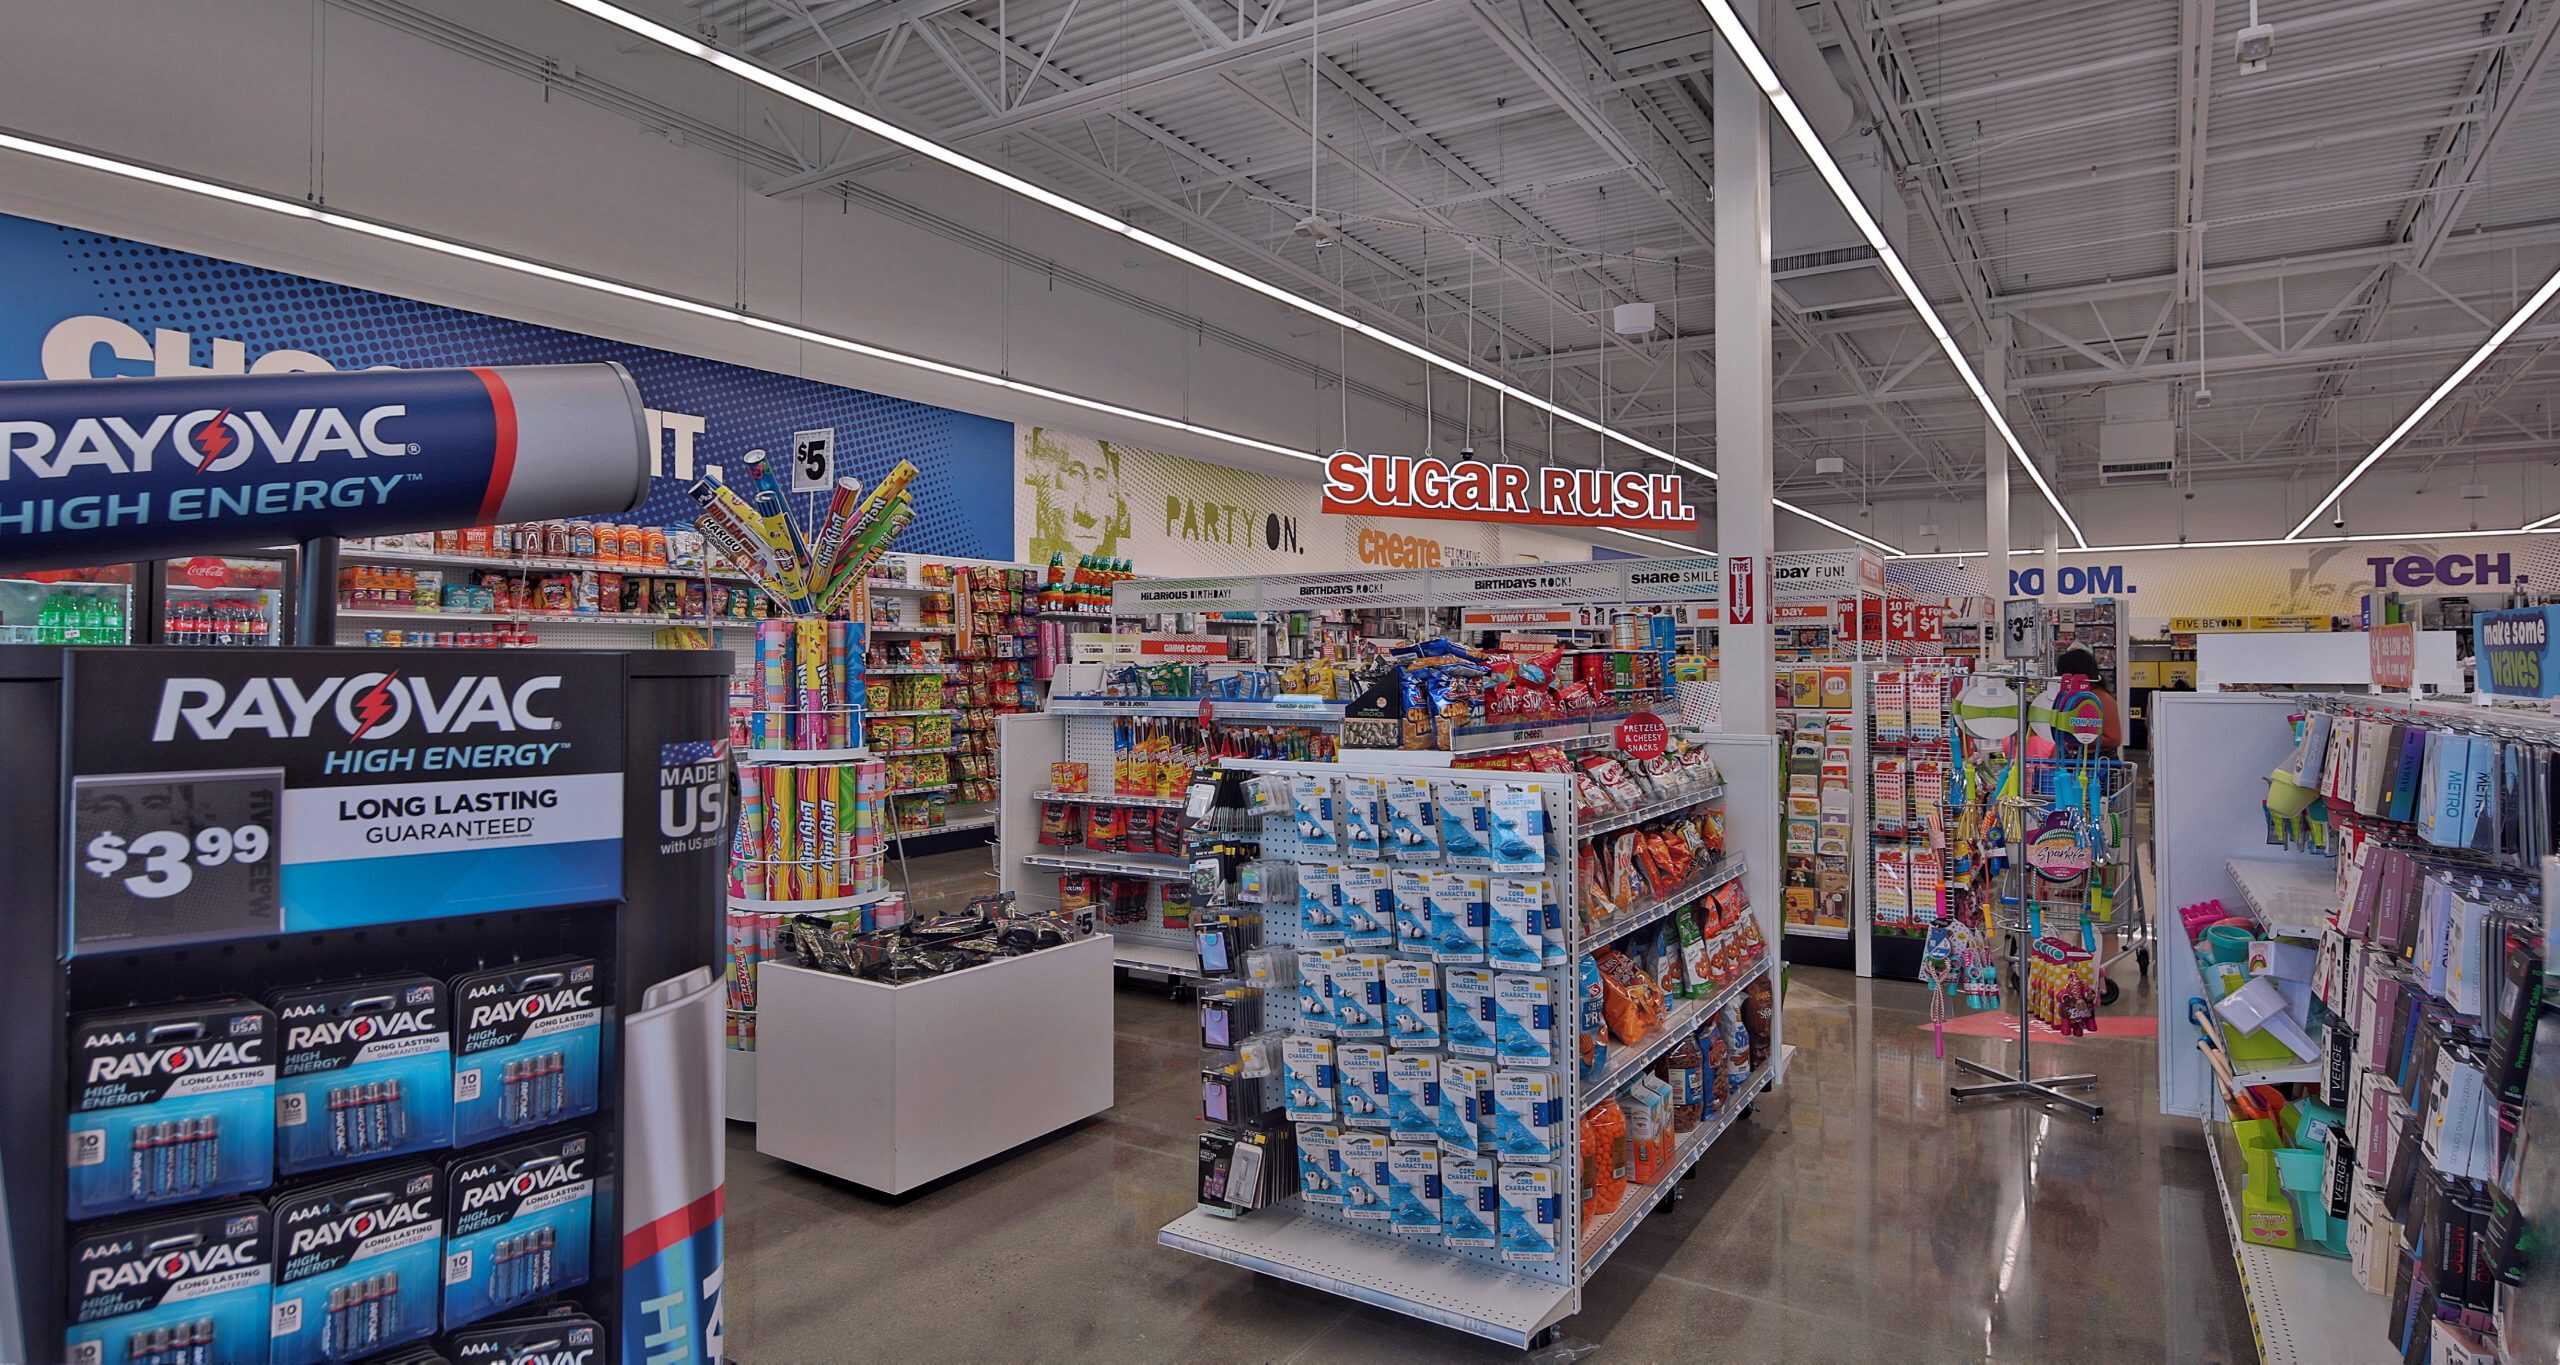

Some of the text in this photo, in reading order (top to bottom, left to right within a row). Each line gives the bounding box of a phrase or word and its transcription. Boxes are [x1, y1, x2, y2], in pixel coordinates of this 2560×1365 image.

[796, 439, 827, 481] $5
[703, 518, 742, 552] HARIBO
[1166, 494, 1304, 555] PARTY ON.
[1731, 562, 1749, 573] FIRE
[1815, 566, 1845, 578] FUN!
[1540, 575, 1572, 588] ROCK!
[1889, 601, 1903, 612] 10
[1919, 607, 1927, 616] 4
[1491, 613, 1549, 623] YUMMY FUN.
[1891, 612, 1915, 638] $1
[1919, 616, 1942, 640] $1
[2176, 618, 2242, 628] FIVE BEYOND
[2484, 618, 2545, 646] make some
[2490, 649, 2539, 689] waves
[1623, 723, 1665, 733] PRETZELS
[1634, 733, 1662, 742] CHEESY
[1627, 743, 1659, 752] SNACKS
[323, 747, 416, 775] HIGH
[661, 764, 717, 788] MADE
[338, 788, 559, 822] LONG LASTING
[2446, 769, 2463, 819] METRO
[661, 838, 686, 856] with
[688, 837, 702, 851] US
[1076, 914, 1094, 936] $5
[470, 985, 593, 1029] RAYOVAC
[288, 1008, 436, 1051] RAYOVAC
[535, 1012, 594, 1029] LONG LASTING
[368, 1037, 440, 1053] LONG LASTING
[467, 1028, 496, 1042] HIGH
[88, 1040, 262, 1083] RAYOVAC
[286, 1051, 321, 1065] HIGH
[2332, 1043, 2343, 1092] VERGE
[181, 1069, 265, 1087] LONG LASTING
[85, 1083, 127, 1099] HIGH
[461, 1158, 586, 1213] RAYOVAC
[2335, 1154, 2347, 1203] VERGE
[526, 1184, 586, 1206] LONG LASTING
[289, 1196, 432, 1257] RAYOVAC
[459, 1208, 489, 1225] HIGH
[365, 1225, 433, 1250] LONG LASTING
[84, 1239, 259, 1296] RAYOVAC
[286, 1251, 321, 1271] HIGH
[177, 1268, 260, 1292] LONG LASTING
[80, 1293, 124, 1311] HIGH
